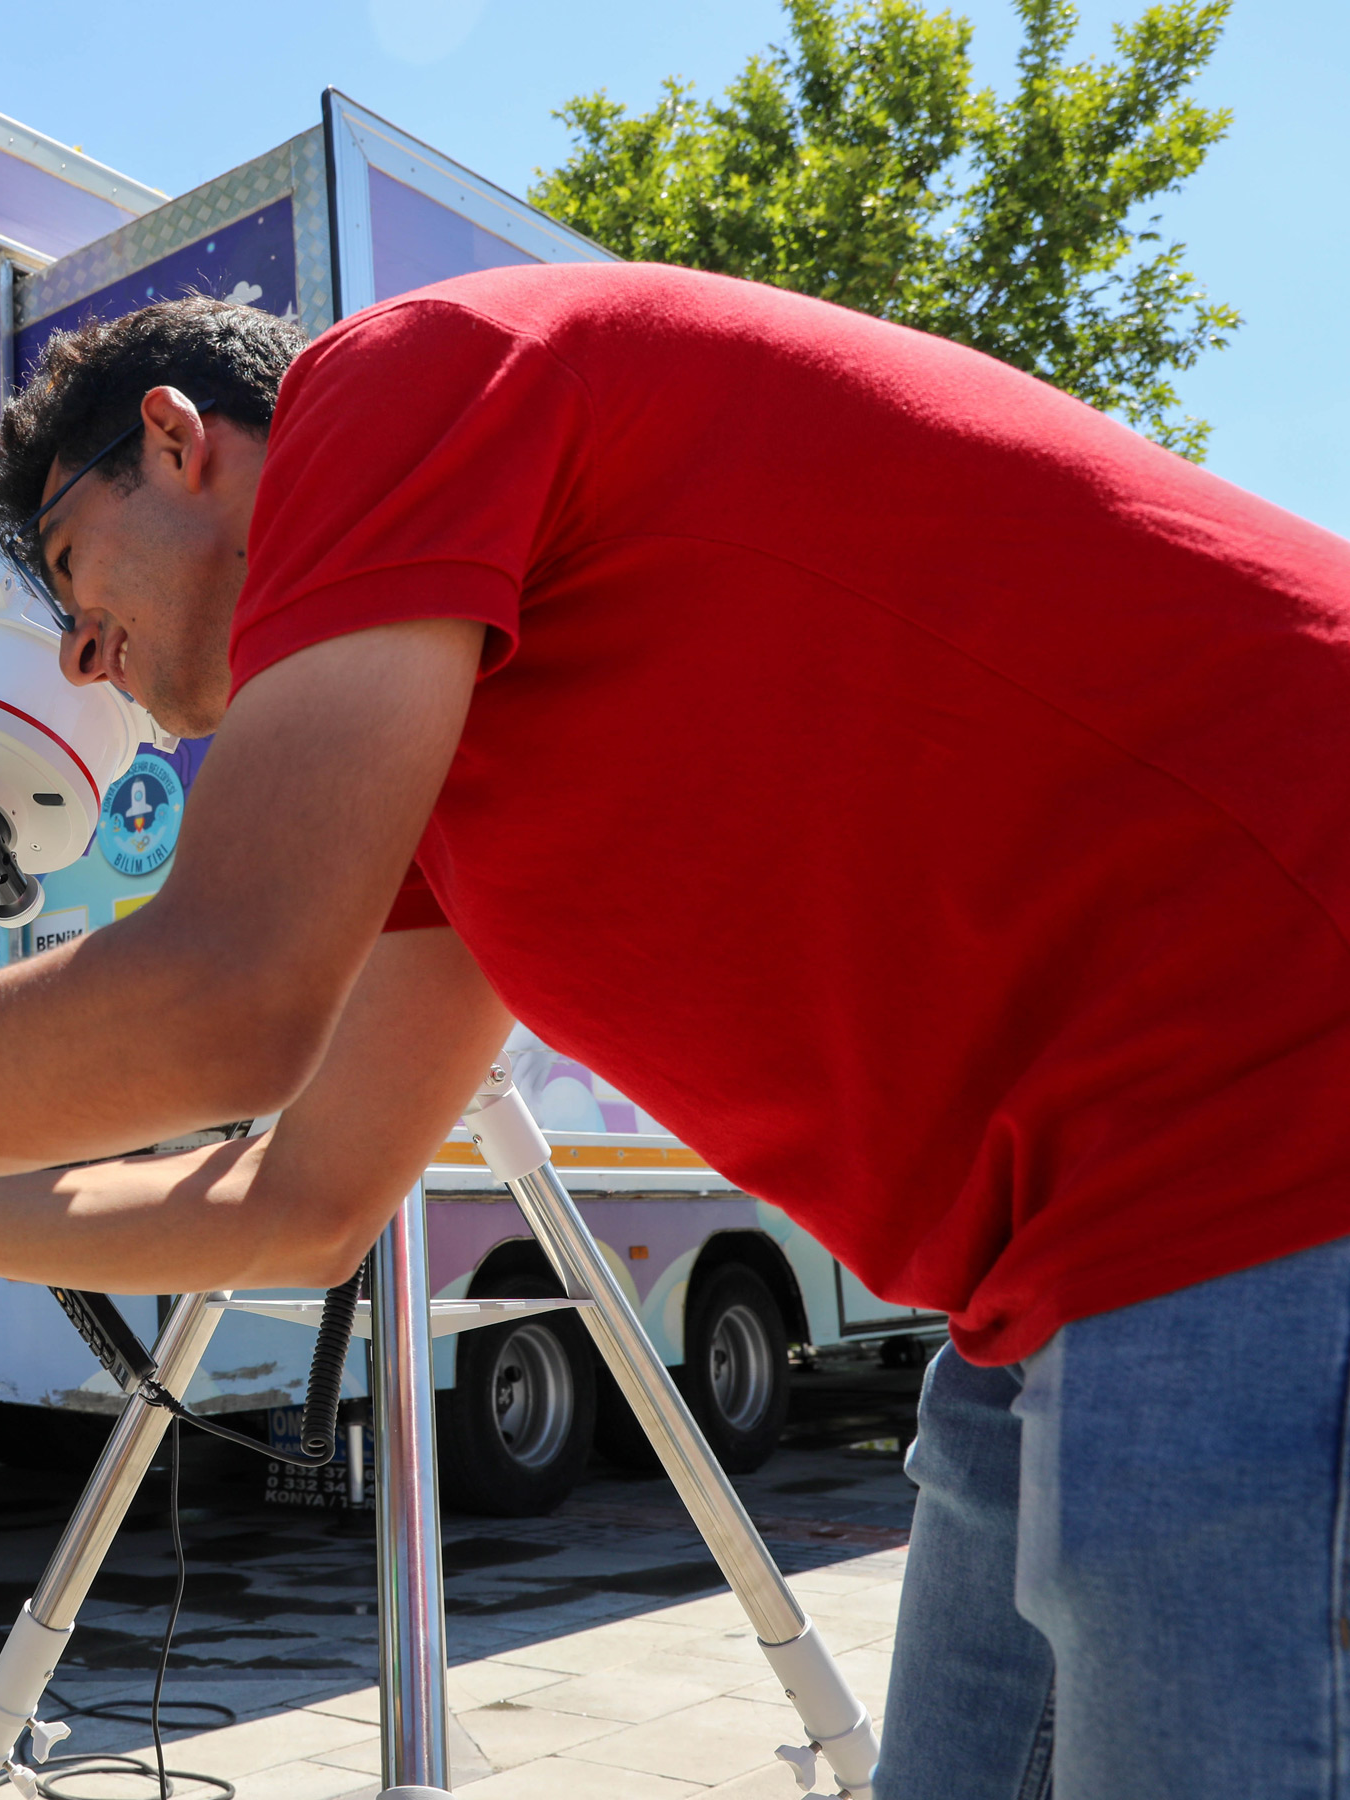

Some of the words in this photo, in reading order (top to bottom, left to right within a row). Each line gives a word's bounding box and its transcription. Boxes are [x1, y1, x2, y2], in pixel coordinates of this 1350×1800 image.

[113, 852, 143, 873] BİLİM
[147, 844, 168, 868] TIRI
[268, 1462, 280, 1474] 0
[284, 1464, 318, 1477] 532
[267, 1476, 279, 1488] 0
[284, 1478, 318, 1491] 332
[264, 1490, 325, 1506] KONYA
